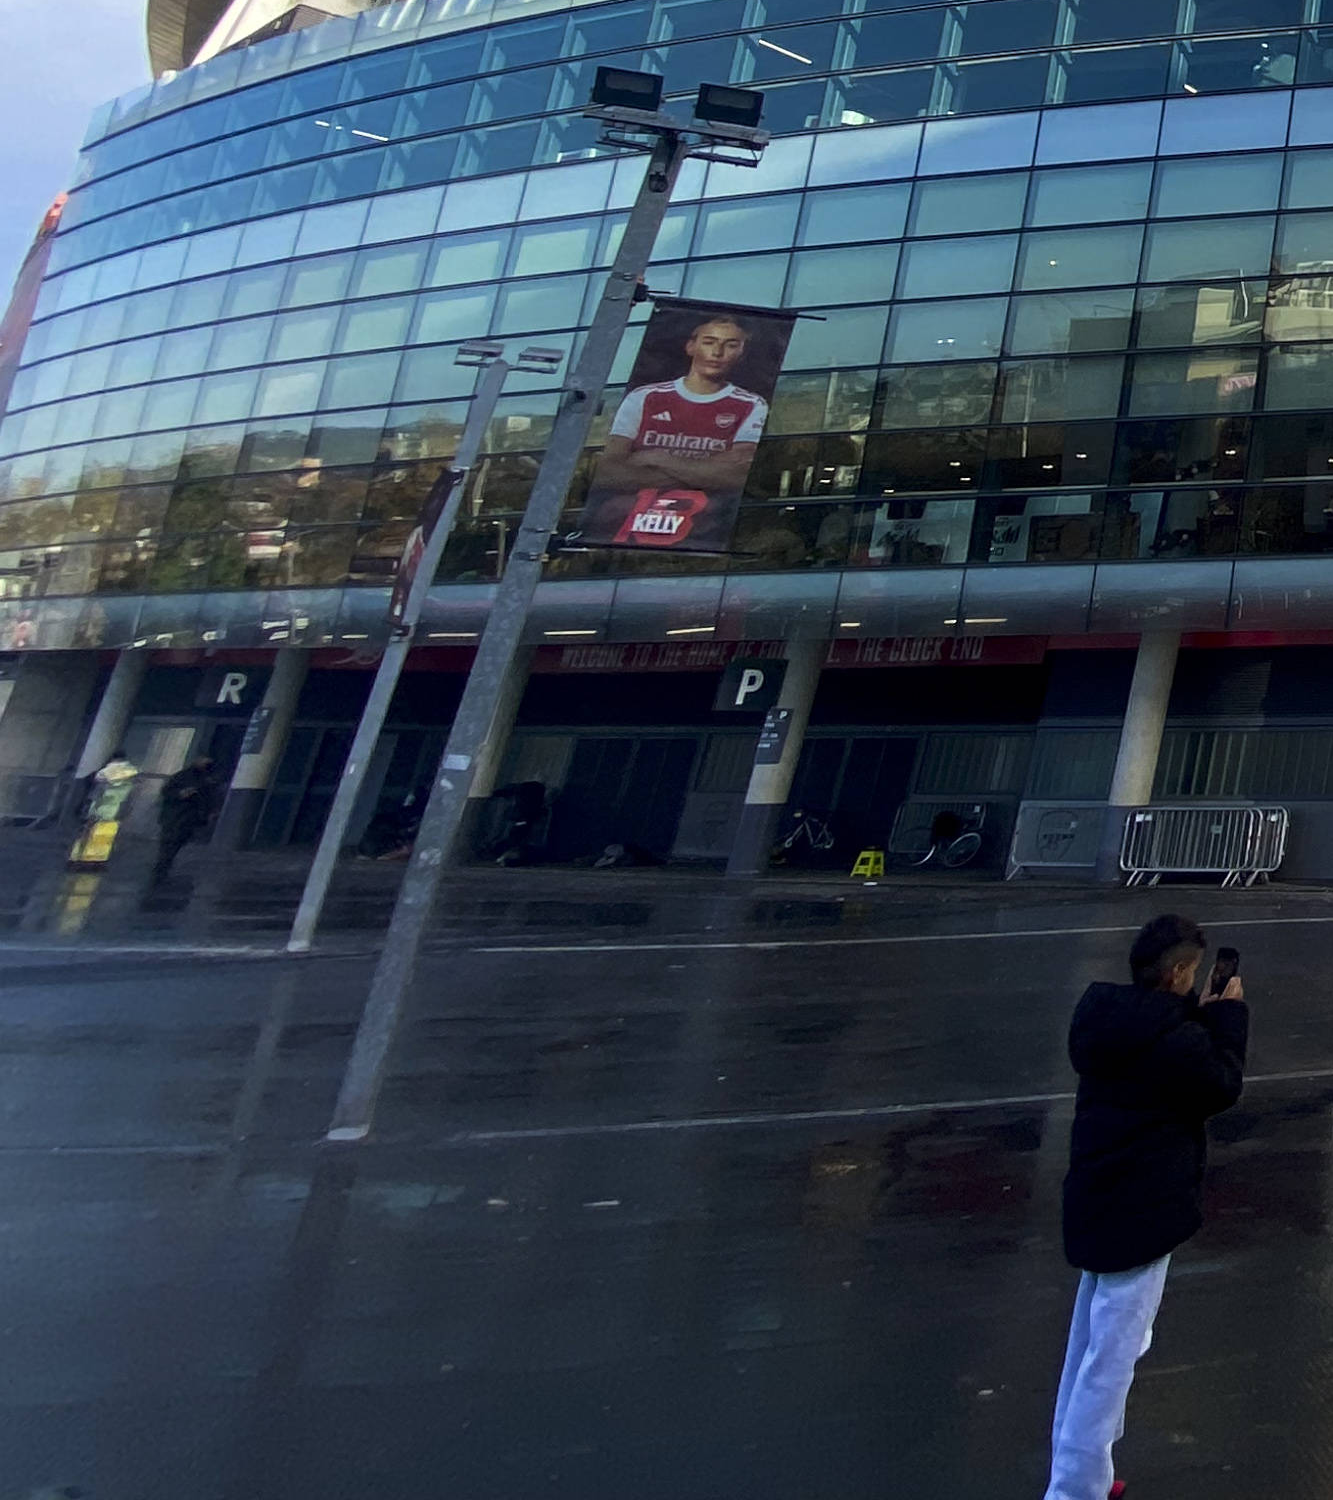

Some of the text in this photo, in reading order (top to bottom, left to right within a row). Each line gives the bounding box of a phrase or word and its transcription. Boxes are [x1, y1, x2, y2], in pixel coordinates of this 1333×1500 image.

[642, 431, 727, 451] Emirates
[631, 514, 685, 534] KELLY
[950, 635, 985, 660] END
[216, 672, 248, 705] R
[734, 668, 765, 706] P
